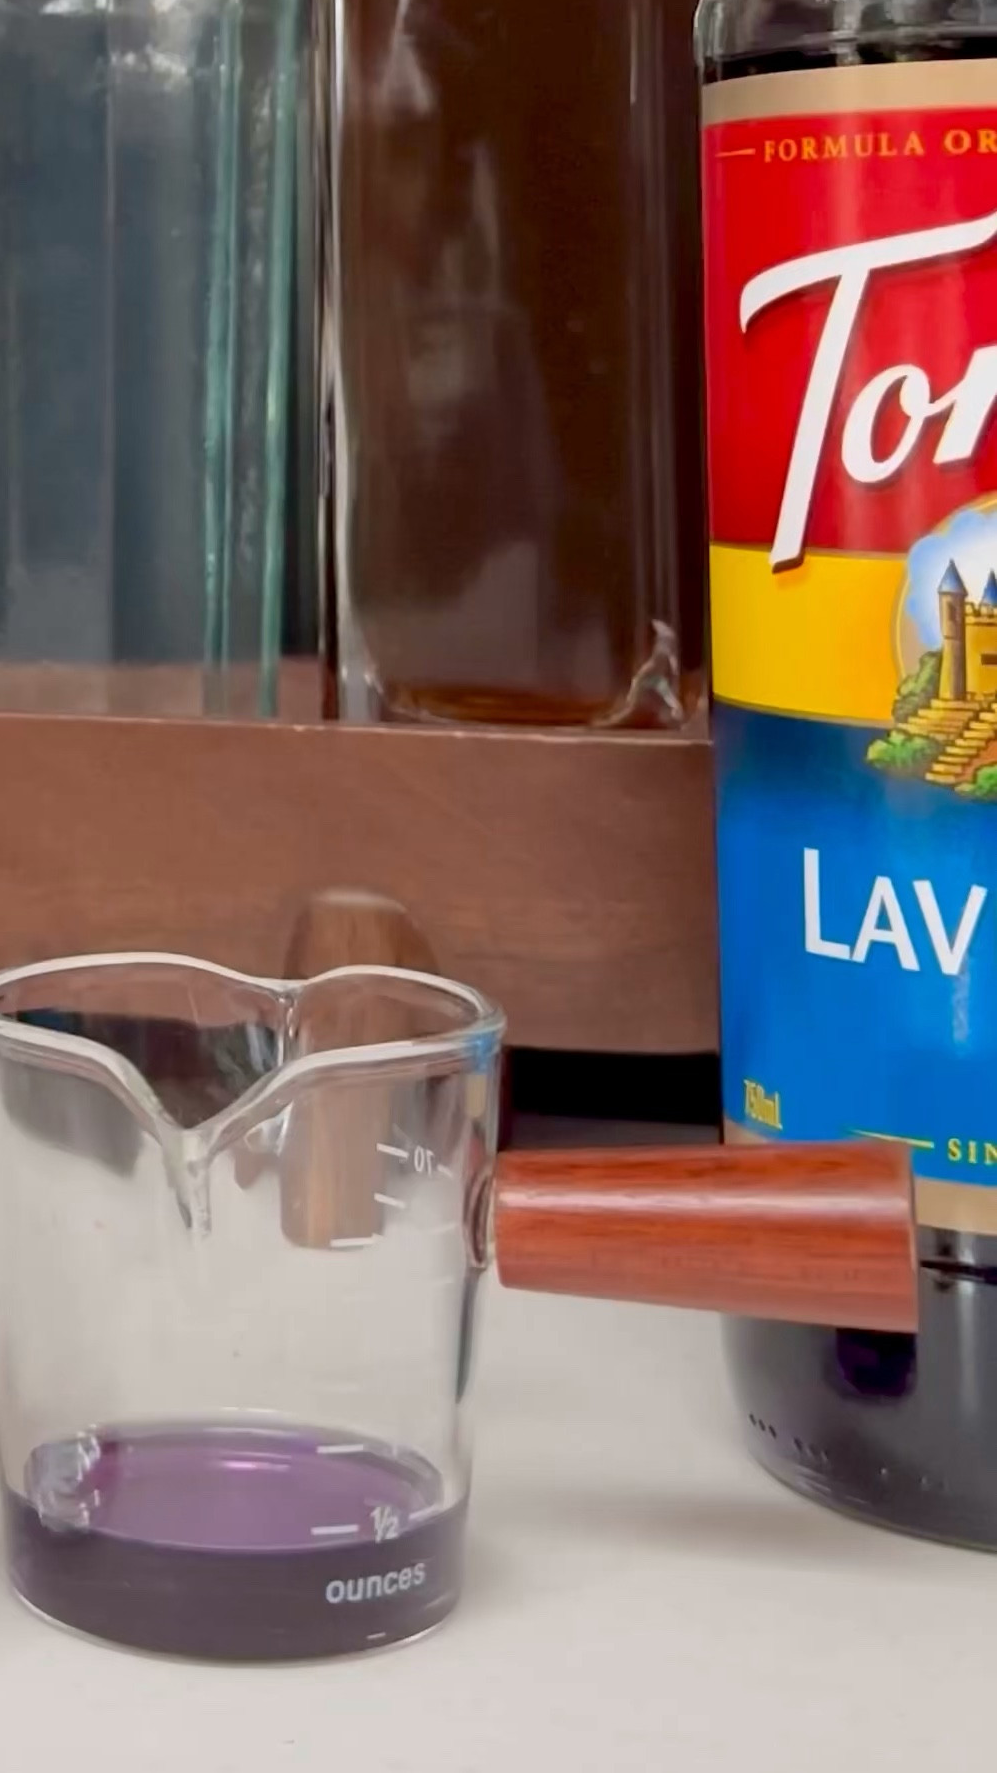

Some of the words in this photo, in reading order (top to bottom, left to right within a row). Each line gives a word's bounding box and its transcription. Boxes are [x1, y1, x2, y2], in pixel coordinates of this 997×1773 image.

[764, 129, 925, 163] FORMULA
[944, 129, 997, 156] OR
[803, 847, 988, 976] LAV
[325, 1562, 426, 1605] ounces
